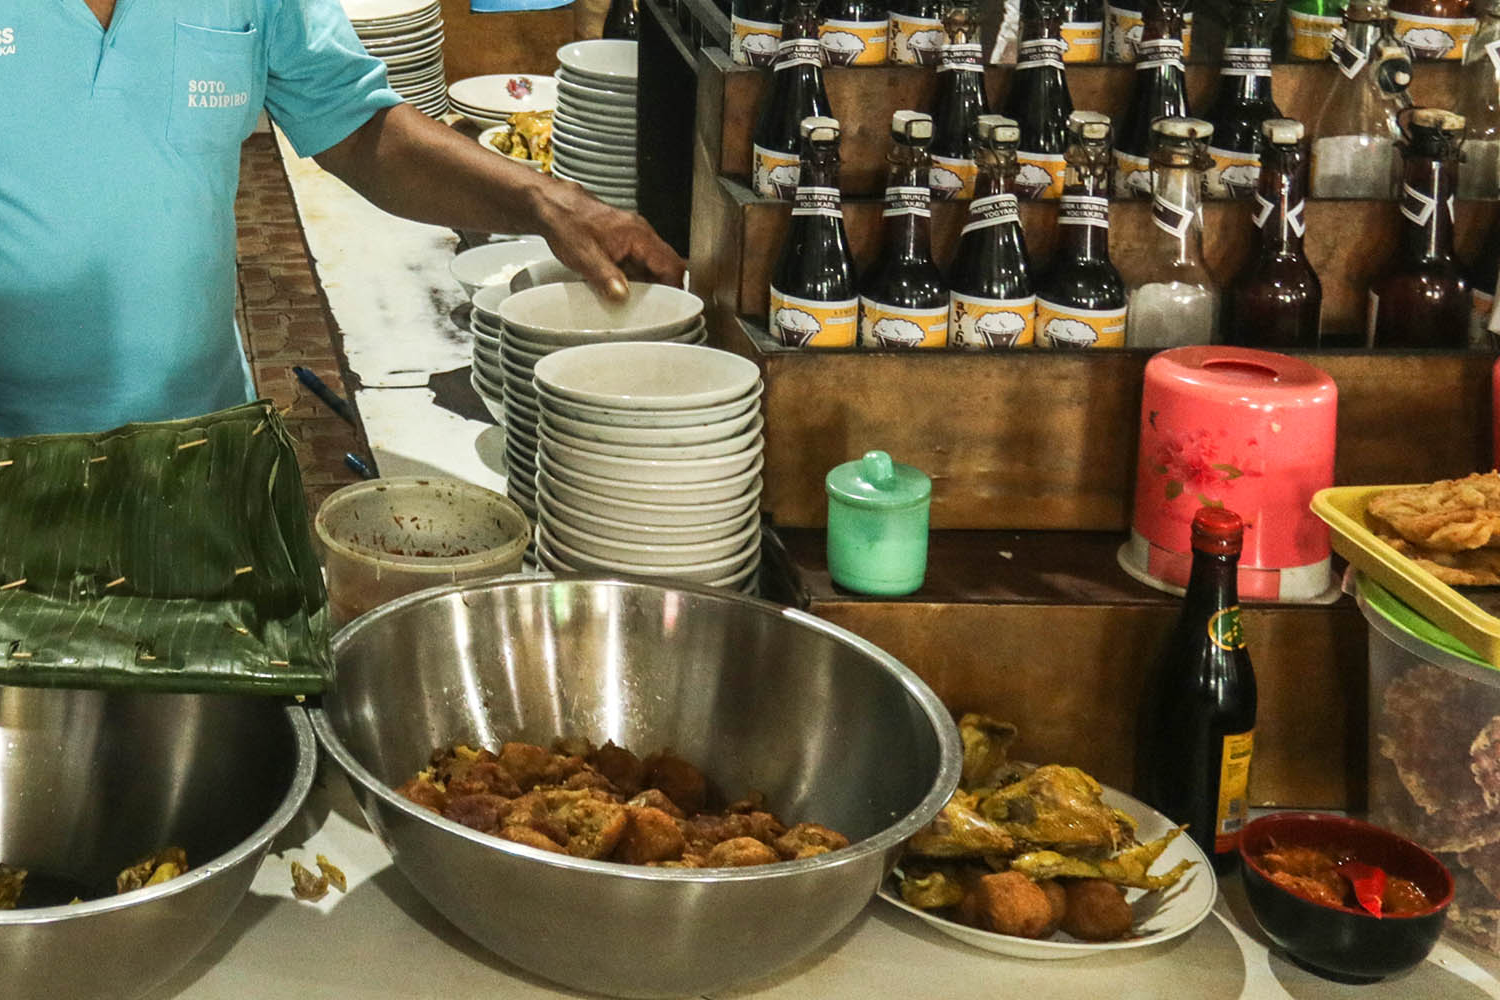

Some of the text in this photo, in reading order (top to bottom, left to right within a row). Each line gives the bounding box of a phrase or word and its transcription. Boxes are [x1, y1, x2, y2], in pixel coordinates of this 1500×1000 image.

[0, 45, 15, 57] KAI
[188, 80, 226, 94] SOTO
[188, 92, 247, 108] KADIPIRO
